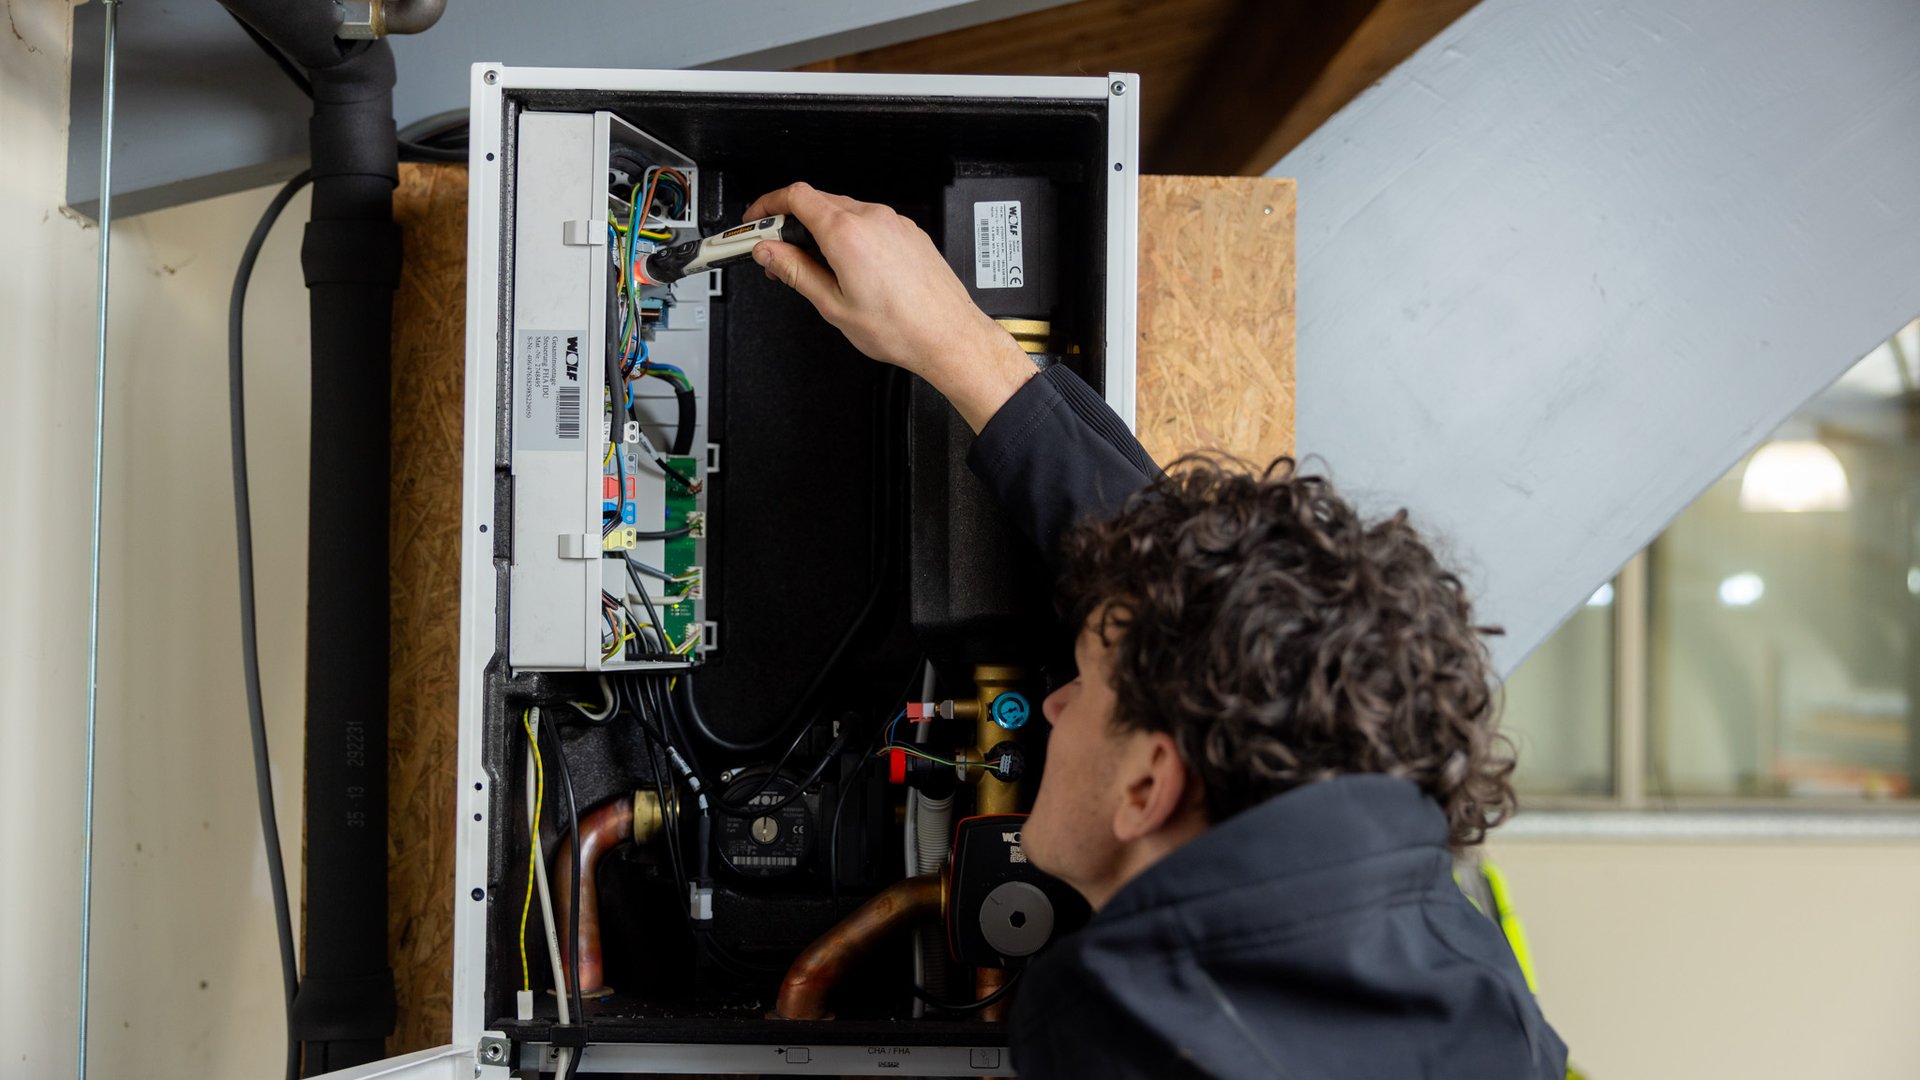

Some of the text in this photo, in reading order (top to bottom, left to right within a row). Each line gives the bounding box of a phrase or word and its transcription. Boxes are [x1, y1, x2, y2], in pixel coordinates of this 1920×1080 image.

[1009, 206, 1018, 236] WOLF
[542, 336, 550, 366] Steuerung
[550, 336, 558, 386] Gesamtmontage
[566, 336, 579, 381] WOLF
[346, 720, 365, 828] 35 13 292231
